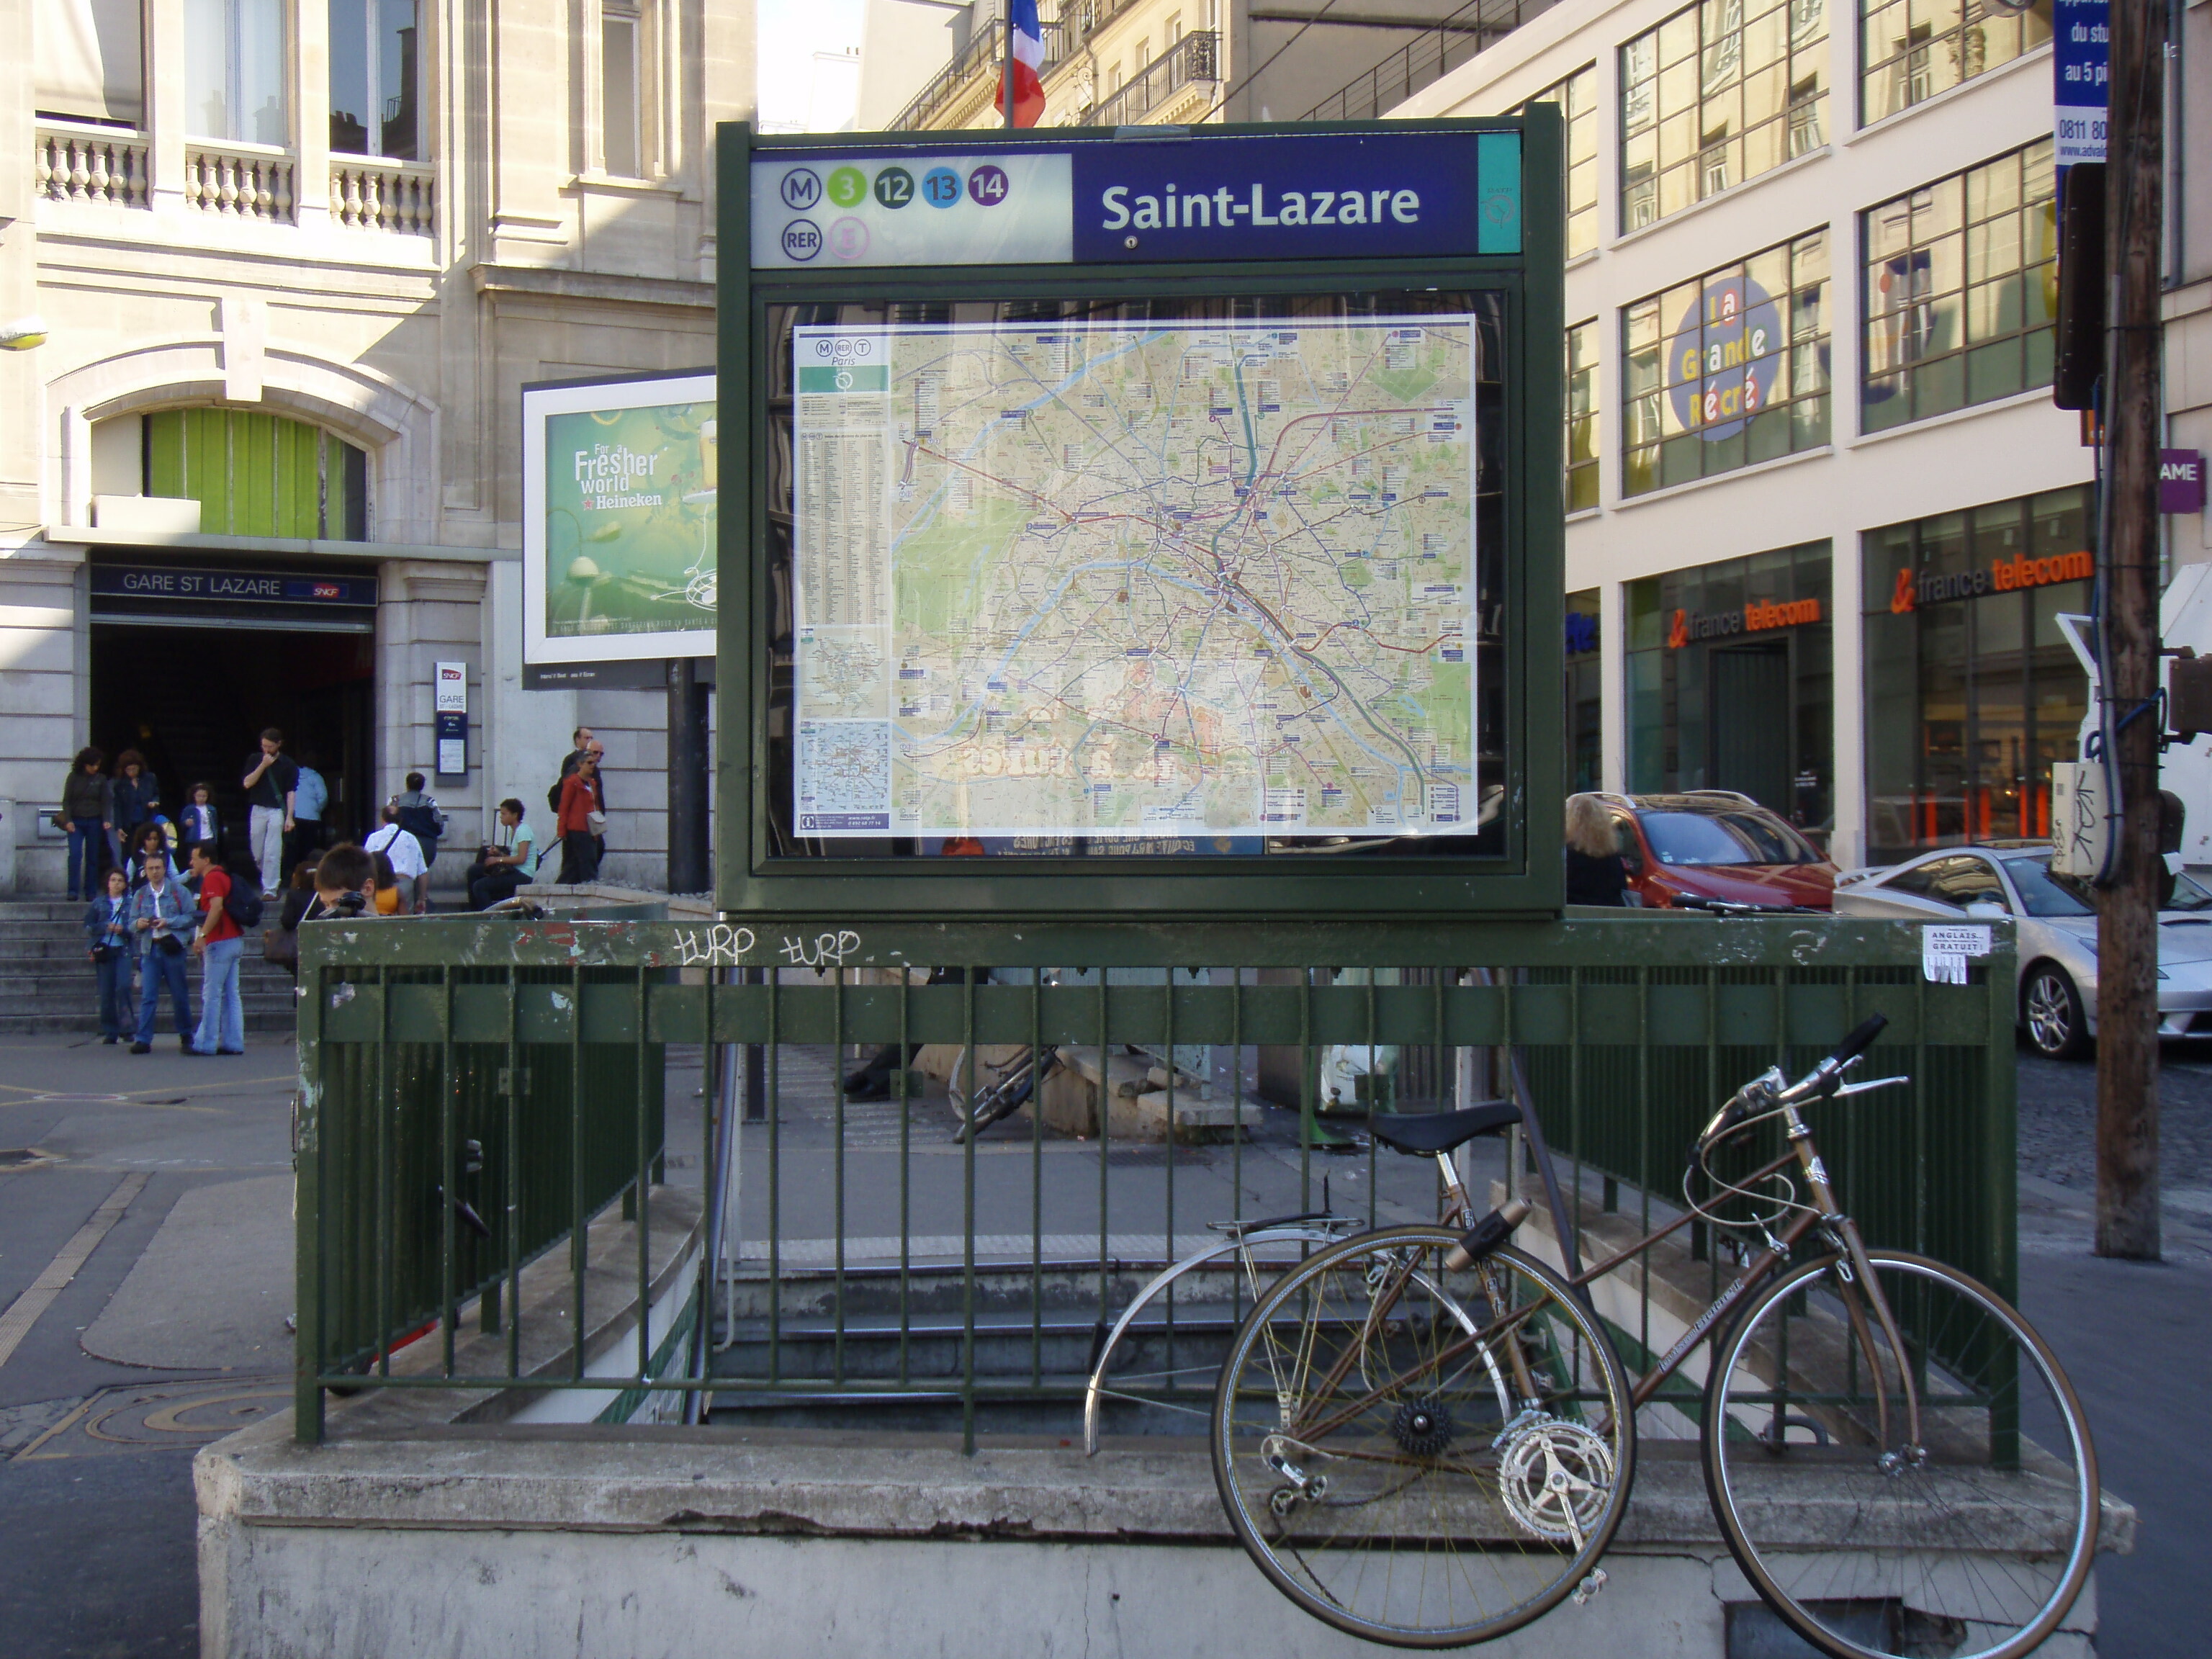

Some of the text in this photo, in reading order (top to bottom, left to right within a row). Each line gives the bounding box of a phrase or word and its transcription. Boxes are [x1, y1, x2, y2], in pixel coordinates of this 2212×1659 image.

[2071, 22, 2088, 42] du
[2065, 63, 2081, 81] au
[2084, 62, 2092, 81] 5
[2059, 119, 2085, 139] 0811
[790, 174, 1004, 201] M 3 12 13 14
[1102, 183, 1420, 230] Saint-Lazare
[787, 232, 817, 248] RER
[1709, 292, 1736, 328] La
[819, 343, 829, 354] M
[858, 343, 867, 353] T
[832, 356, 855, 366] Paris
[595, 444, 623, 456] For a
[575, 446, 658, 481] Fresher
[2160, 462, 2198, 481] AME
[581, 474, 629, 495] world
[595, 493, 662, 510] Heineken
[124, 573, 280, 595] GARE ST LAZARE
[1916, 569, 1986, 603] france
[1990, 550, 2094, 591] telecom
[313, 587, 338, 596] SNCF
[1690, 611, 1740, 640] france
[1744, 597, 1821, 631] telecom
[440, 695, 464, 703] GARE
